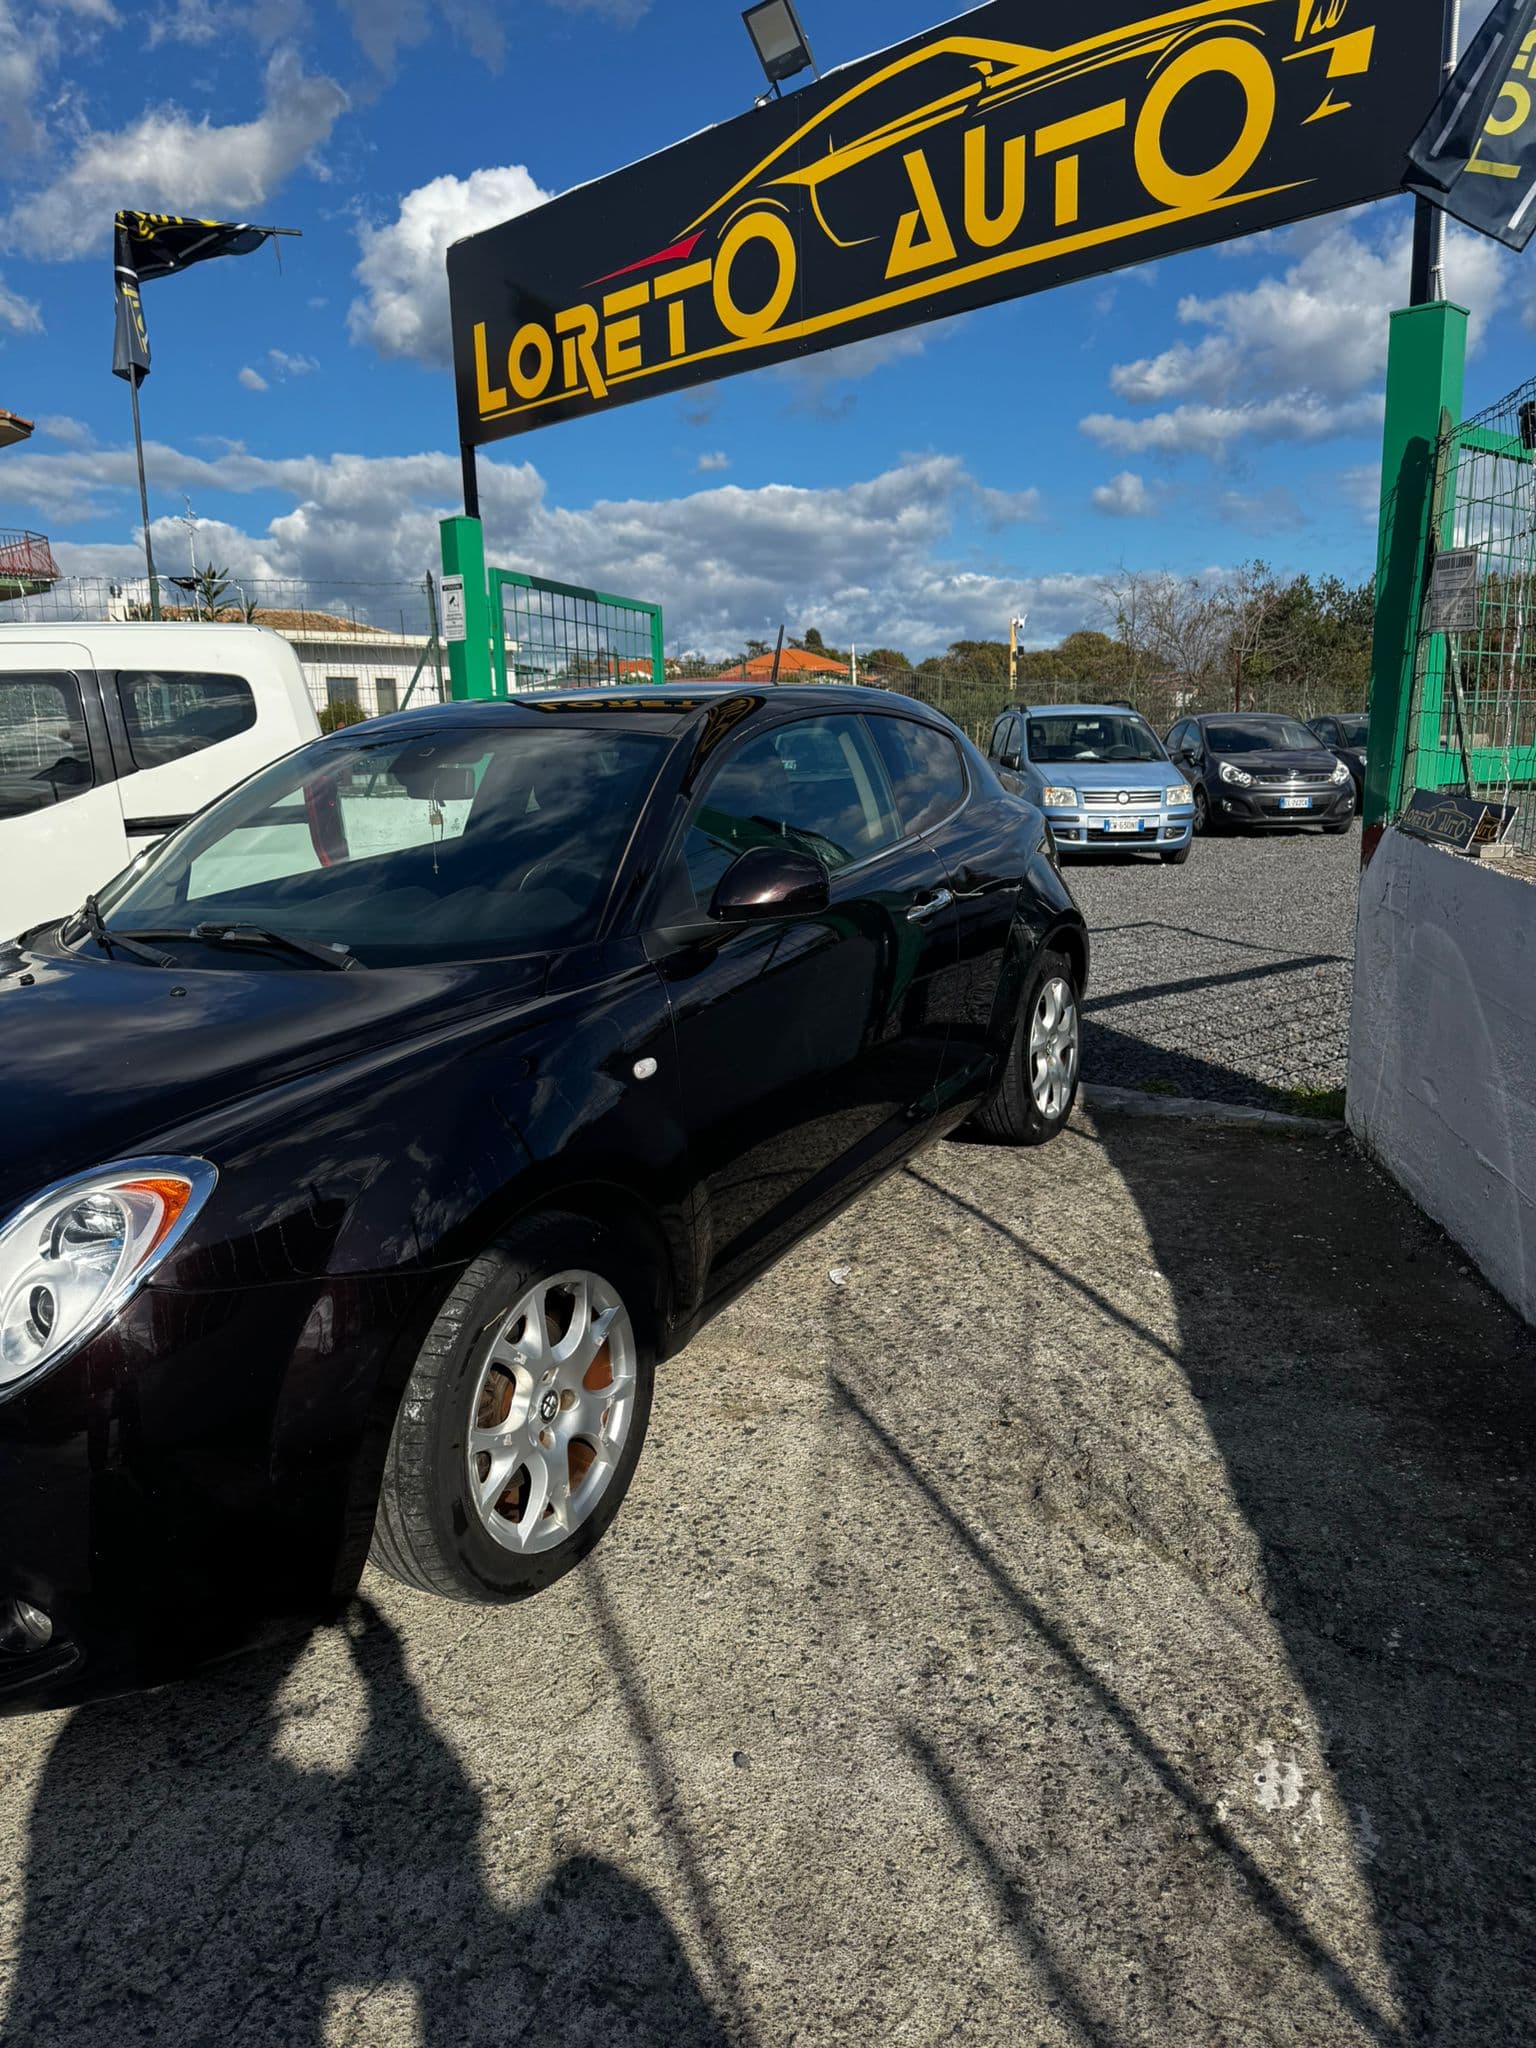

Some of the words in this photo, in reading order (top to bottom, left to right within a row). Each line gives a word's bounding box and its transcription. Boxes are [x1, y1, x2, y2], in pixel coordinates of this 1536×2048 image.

[473, 211, 797, 415] LORETO
[885, 37, 1276, 280] AUTO
[1438, 813, 1467, 839] AUTO
